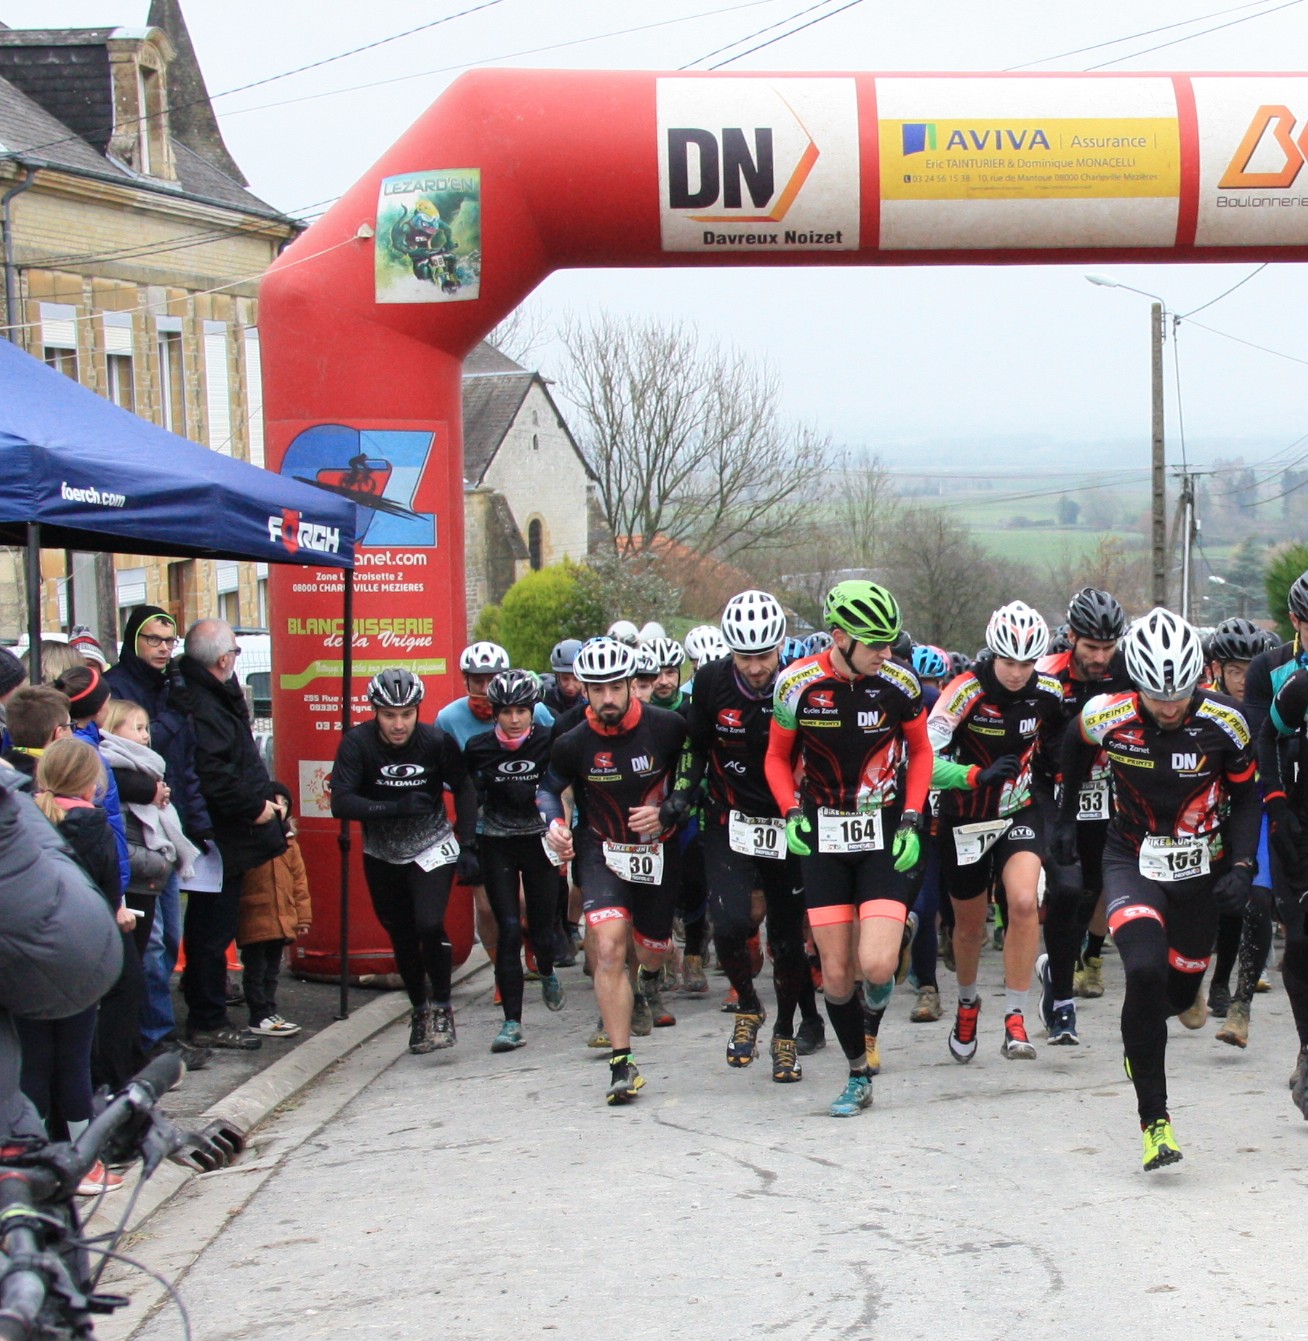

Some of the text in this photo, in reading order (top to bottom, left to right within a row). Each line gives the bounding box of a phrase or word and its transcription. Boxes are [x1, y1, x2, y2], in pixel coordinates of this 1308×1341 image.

[946, 129, 1147, 151] AVIVA Assurance
[668, 128, 774, 209] DN
[925, 159, 944, 169] Eric
[946, 158, 1005, 169] TAINTURIER
[1017, 158, 1074, 171] Dominique
[1076, 158, 1136, 168] MONACELLI
[1005, 174, 1016, 182] de
[703, 230, 843, 245] Davreux Noizet
[61, 482, 126, 508] foerch.com
[316, 573, 338, 581] Zone
[397, 572, 404, 581] 2
[319, 583, 379, 592] CHARVILLE
[381, 583, 424, 592] MEZIERES
[288, 618, 433, 635] BLANCISSERIE
[324, 634, 344, 647] de
[377, 631, 433, 652] Vrigne
[857, 711, 879, 727] DN
[1099, 705, 1132, 720] PEINTS
[1020, 718, 1036, 734] DN
[631, 755, 649, 772] DN
[724, 761, 747, 773] AG
[1171, 753, 1197, 770] DN
[376, 778, 427, 787] SALOMON
[1079, 792, 1103, 812] 53
[753, 827, 777, 849] 30
[840, 819, 876, 842] 164
[629, 856, 653, 875] 30
[1165, 848, 1203, 872] 153
